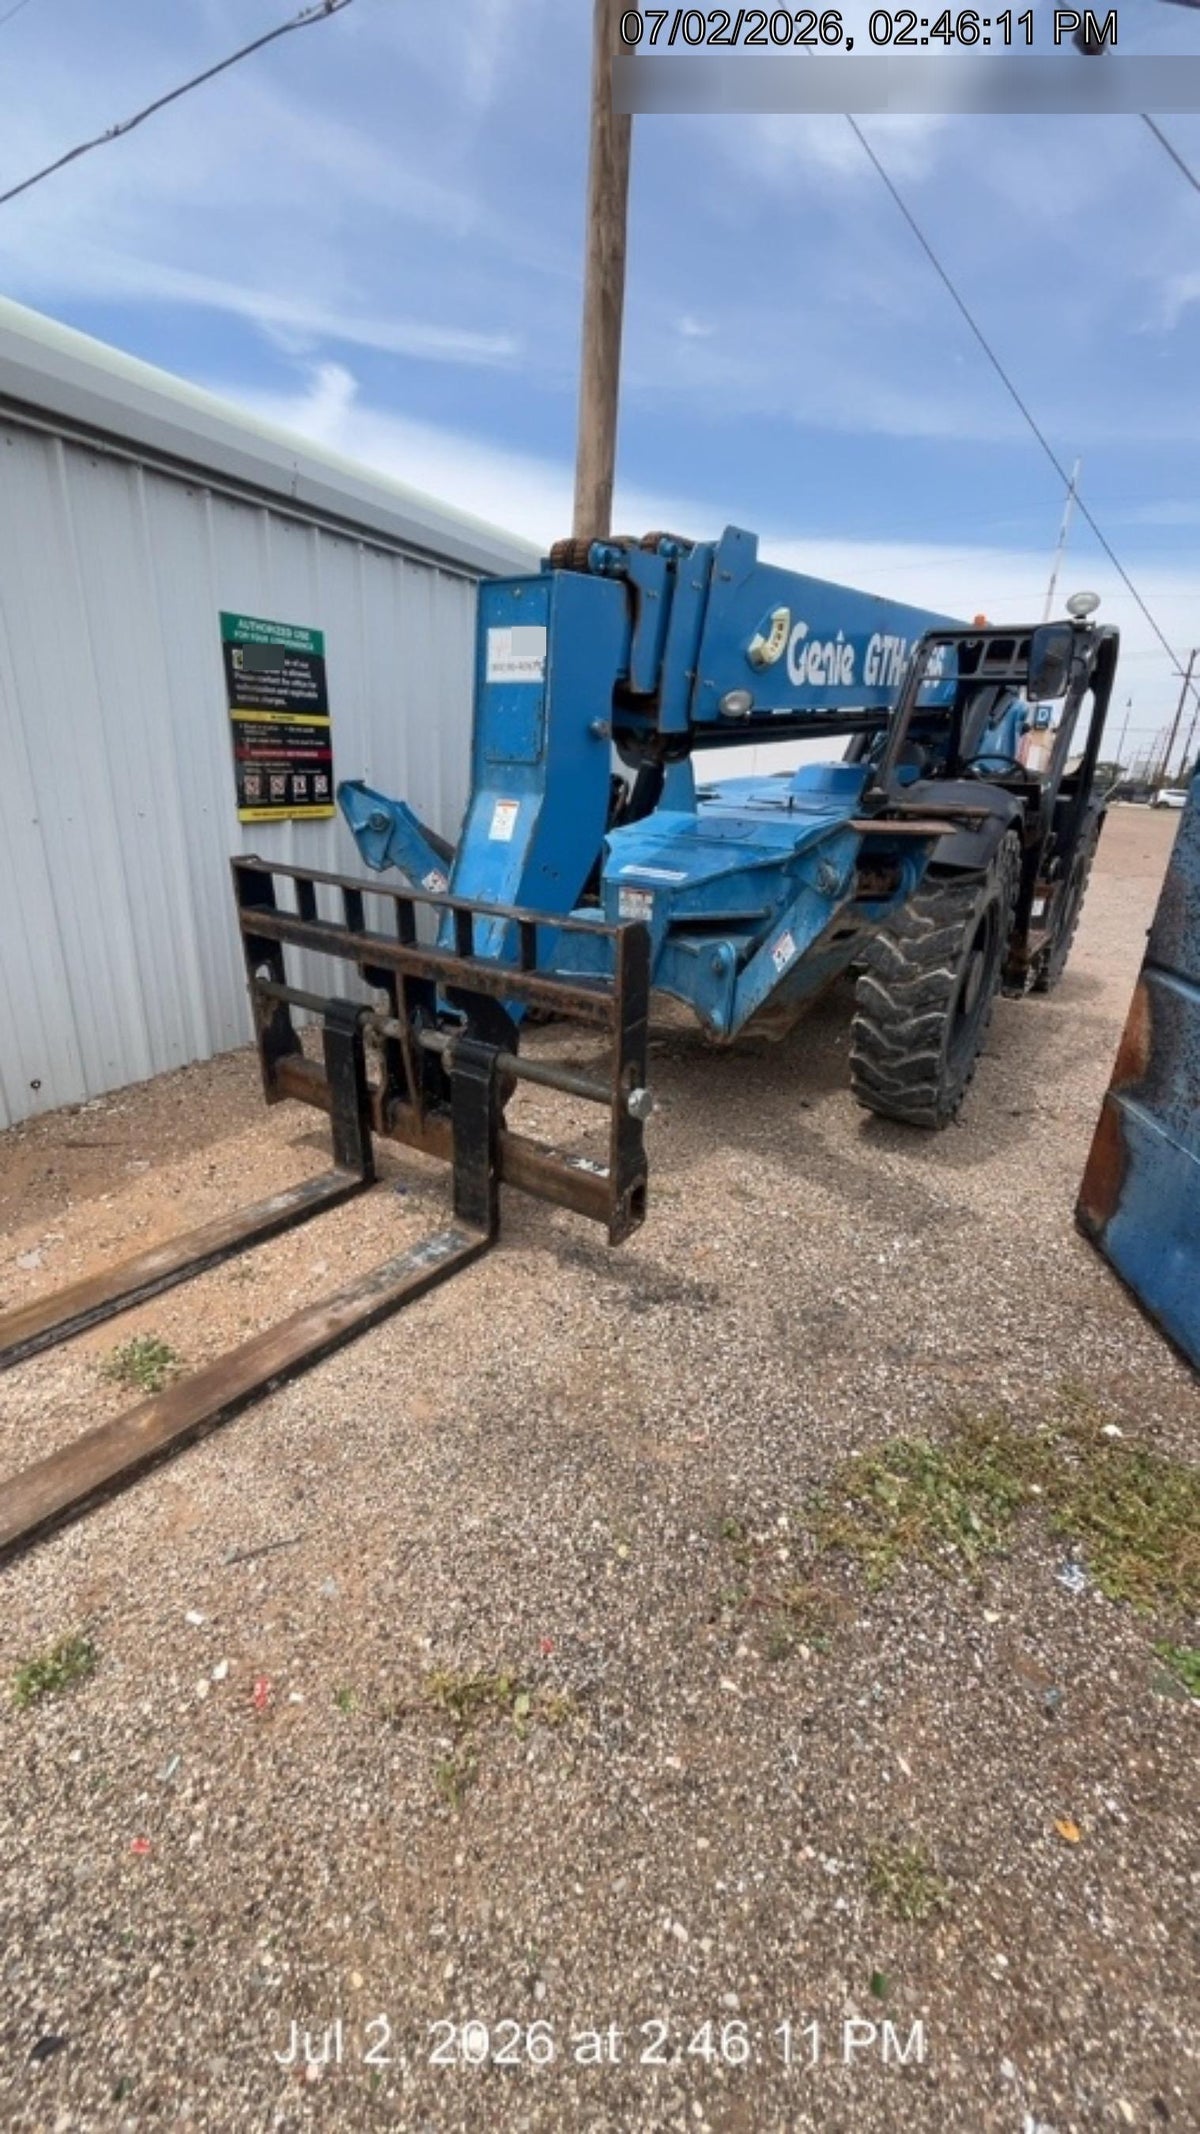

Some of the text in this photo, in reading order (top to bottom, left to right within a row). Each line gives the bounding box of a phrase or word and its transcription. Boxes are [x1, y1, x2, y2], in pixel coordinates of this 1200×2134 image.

[234, 630, 313, 651] FOR YOUR CONVENIENCE
[238, 618, 309, 641] AUTHORIZED USE
[787, 621, 854, 686] Genie
